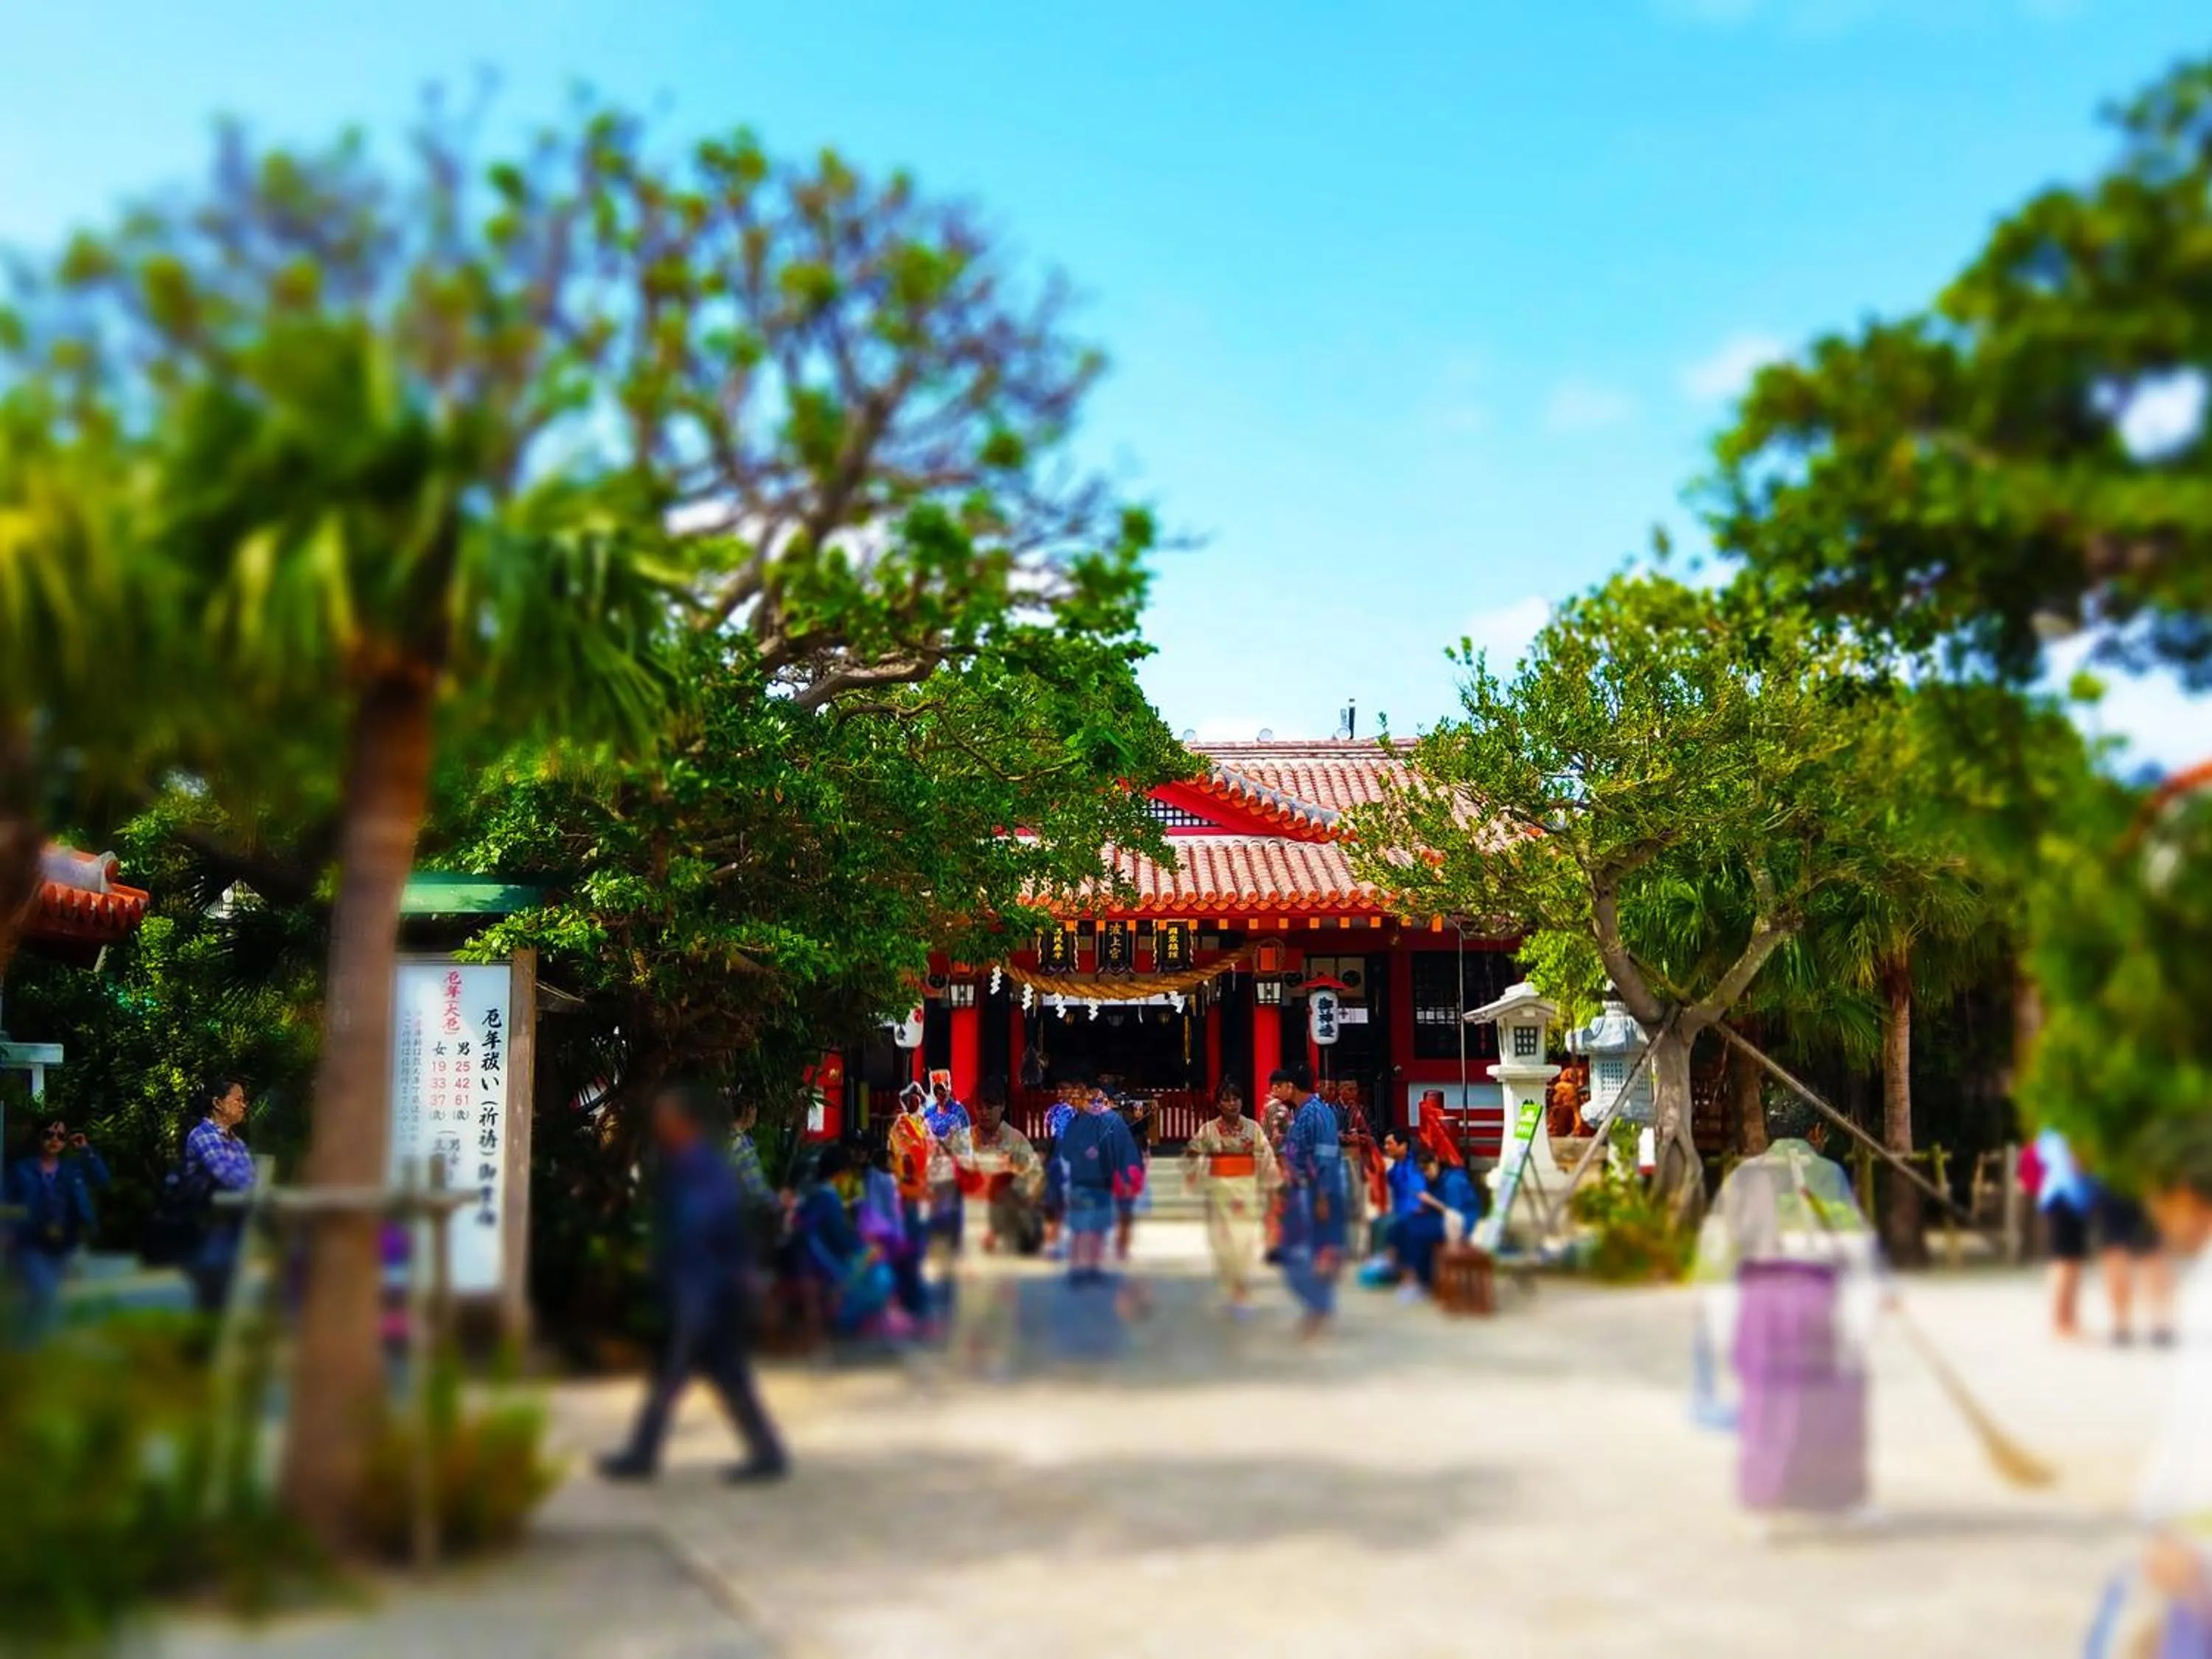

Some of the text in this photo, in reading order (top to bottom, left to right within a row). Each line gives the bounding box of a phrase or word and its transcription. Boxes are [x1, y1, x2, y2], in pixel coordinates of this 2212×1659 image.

[433, 1040, 447, 1055] 女
[458, 1041, 470, 1055] 男
[432, 1060, 447, 1073] 19
[455, 1061, 470, 1072] 25
[431, 1077, 447, 1089] 33
[455, 1077, 470, 1089] 42
[431, 1094, 446, 1106] 37
[455, 1094, 469, 1106] 61
